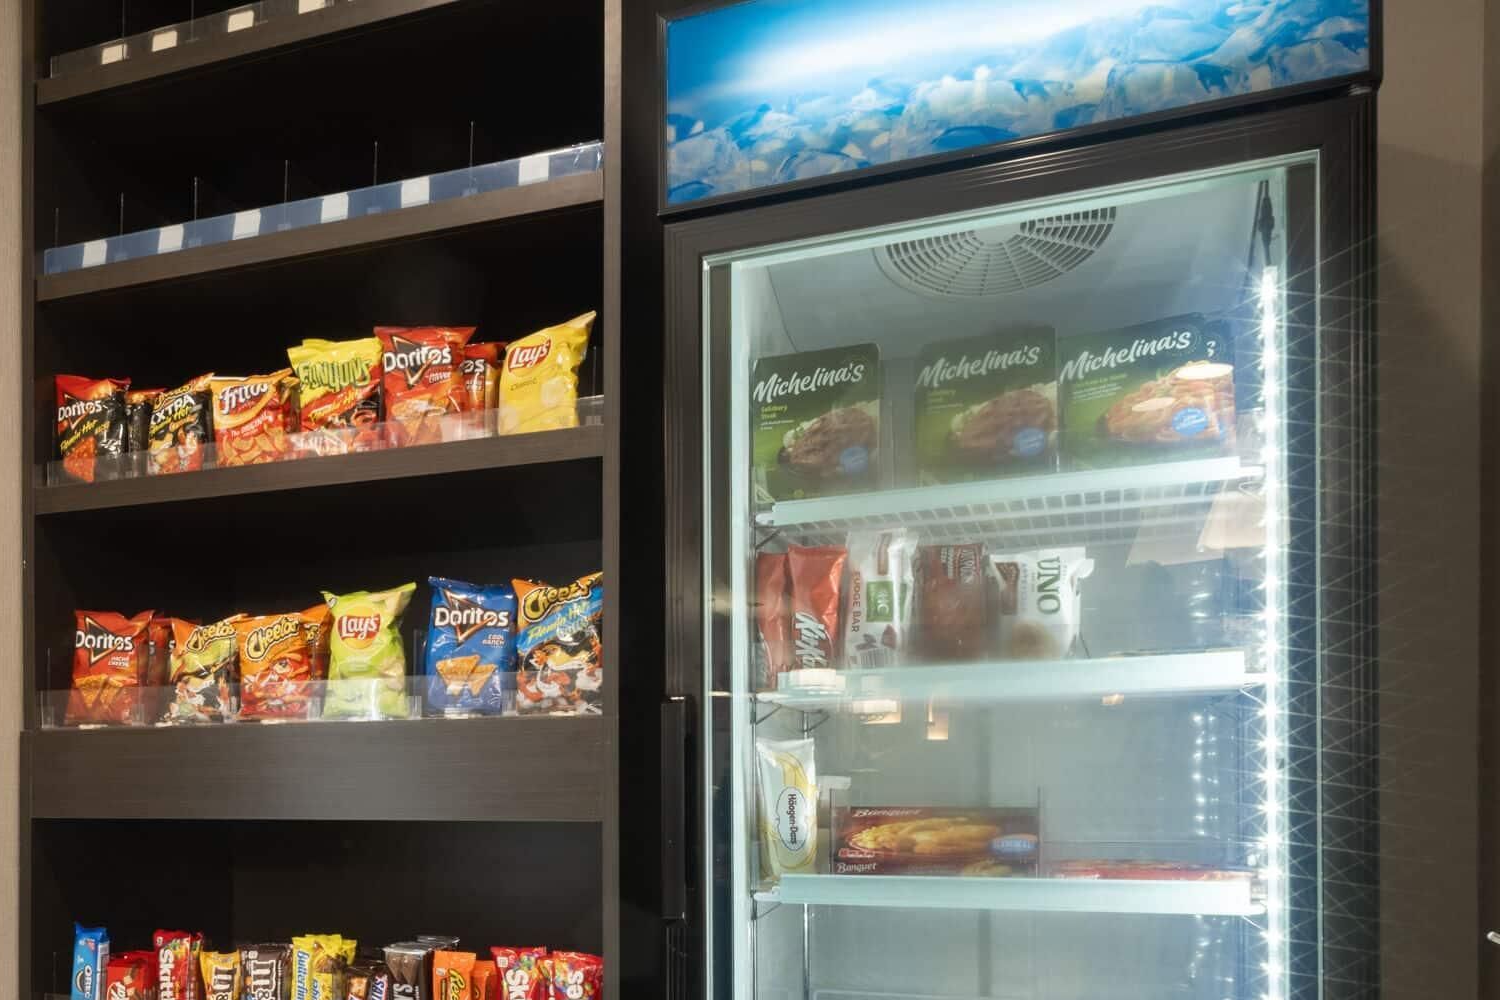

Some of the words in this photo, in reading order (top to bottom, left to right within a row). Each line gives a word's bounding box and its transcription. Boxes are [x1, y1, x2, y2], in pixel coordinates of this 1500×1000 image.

[382, 345, 452, 373] Doritos
[509, 342, 551, 369] Lay's
[917, 344, 1041, 388] Michelina's
[1059, 330, 1192, 385] Michelina's
[752, 362, 866, 403] Michelina's
[57, 399, 102, 423] Doritos
[219, 382, 269, 414] Fritos
[851, 570, 862, 609] FUDGE
[1036, 555, 1061, 616] UNO
[340, 613, 381, 640] Lay's
[433, 606, 509, 629] Doritos
[850, 612, 862, 633] BAR
[75, 630, 134, 651] Doritos
[186, 621, 237, 652] Cheetos
[245, 617, 300, 662] Cheetos
[836, 861, 878, 875] Banquet
